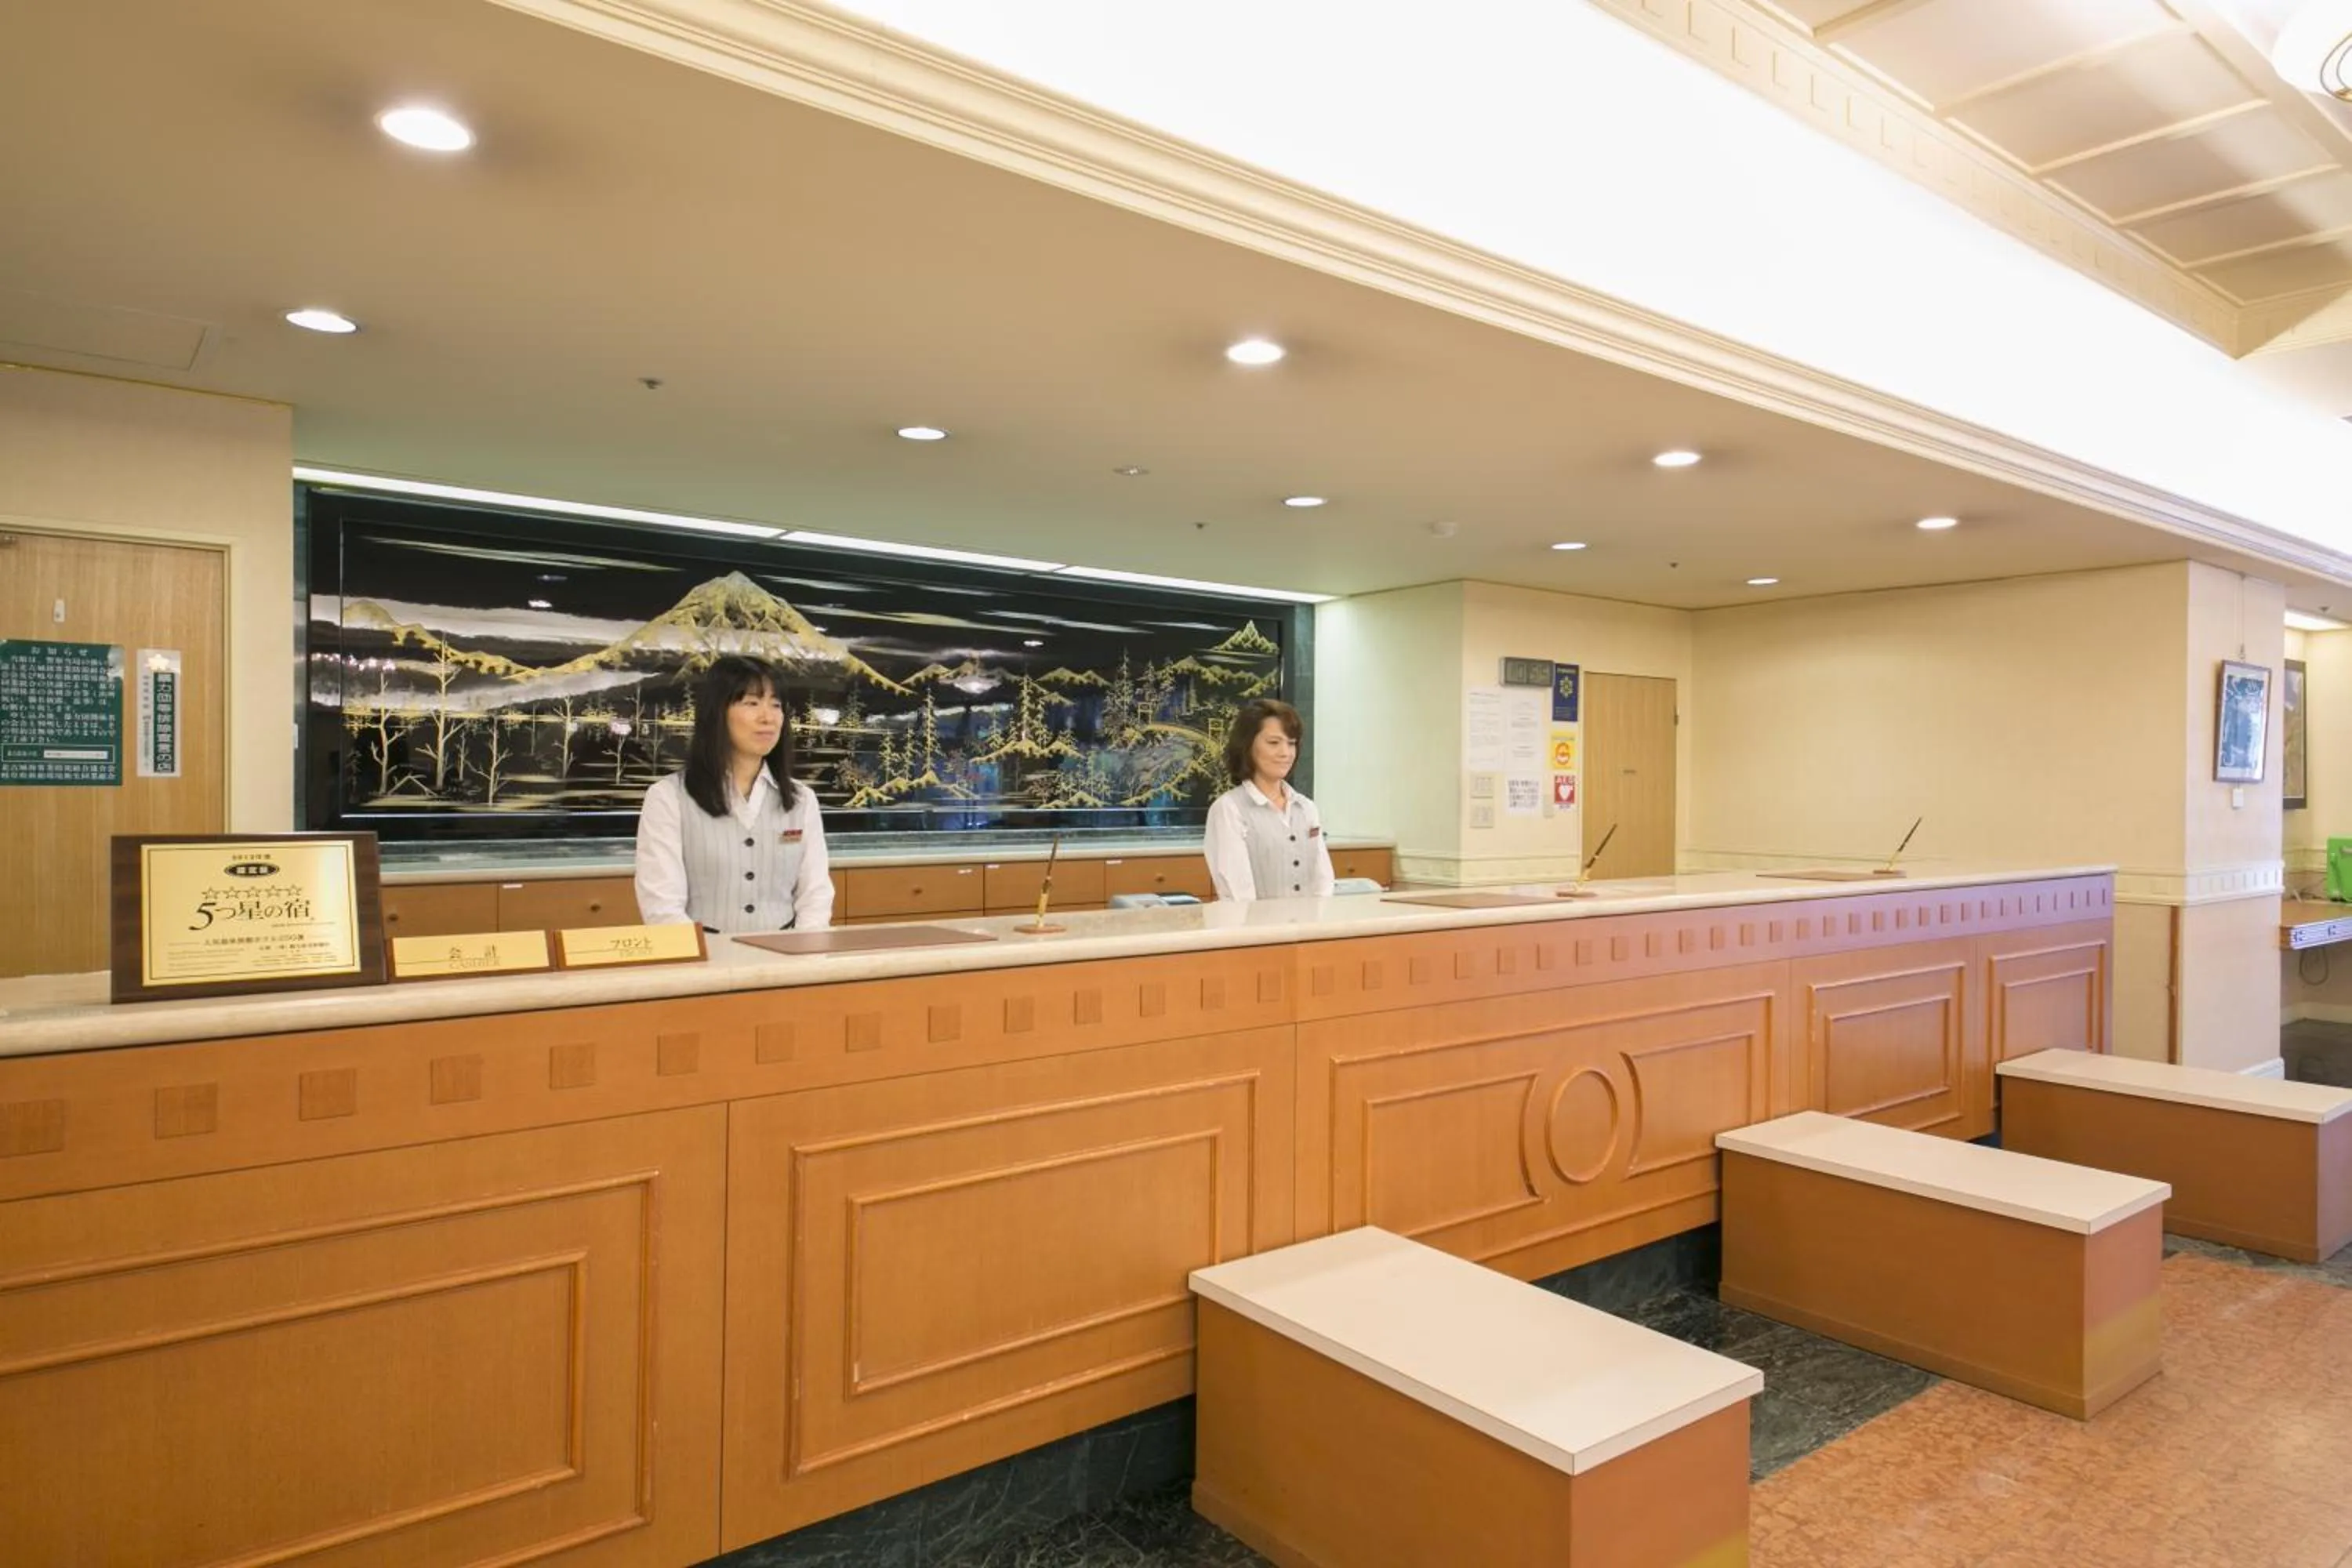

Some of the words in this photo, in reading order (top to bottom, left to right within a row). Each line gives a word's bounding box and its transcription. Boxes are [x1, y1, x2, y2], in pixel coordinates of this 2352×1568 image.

[188, 899, 310, 931] 5つ星の宿
[609, 936, 652, 950] フロント
